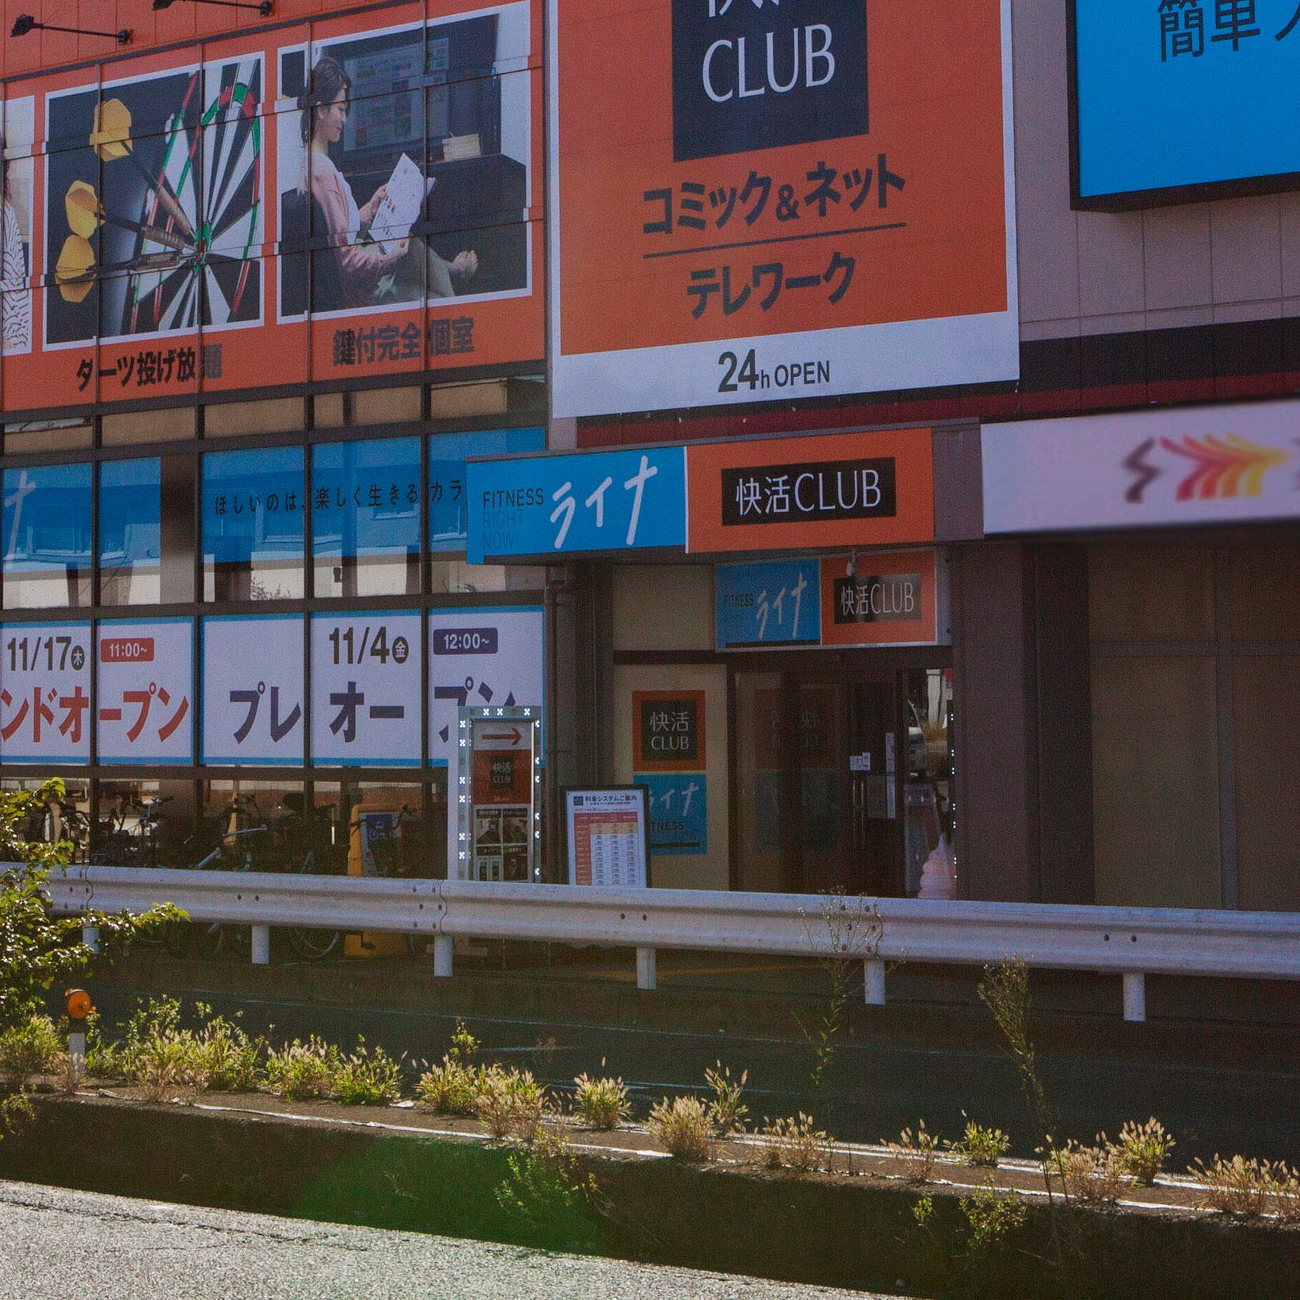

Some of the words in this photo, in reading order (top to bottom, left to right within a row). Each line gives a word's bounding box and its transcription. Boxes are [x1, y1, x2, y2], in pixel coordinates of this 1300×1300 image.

[702, 23, 836, 103] CLUB
[642, 153, 906, 235] コミック&ネット
[686, 251, 857, 320] テレワーク
[76, 344, 224, 392] ダーツ投げ放題
[774, 360, 831, 388] OPEN
[482, 487, 544, 509] FITNESS
[482, 509, 525, 529] RIGHT
[650, 711, 689, 732] 快活
[651, 736, 690, 750] CLUB
[650, 820, 685, 831] TNESS
